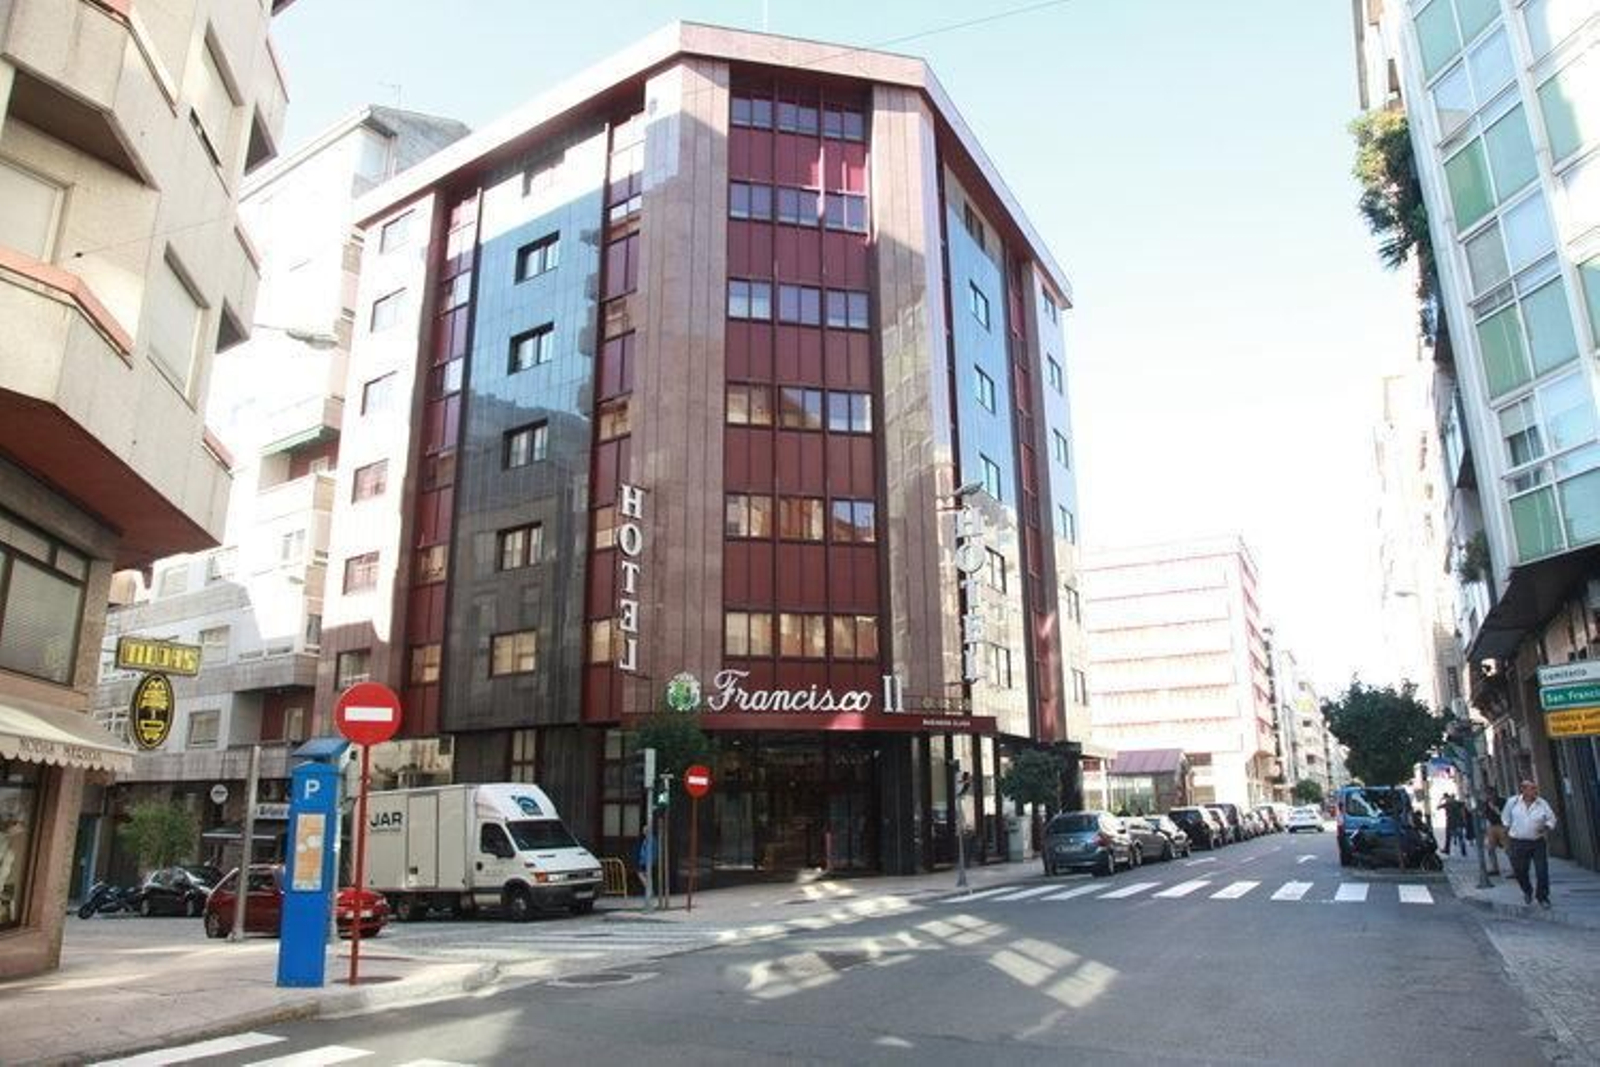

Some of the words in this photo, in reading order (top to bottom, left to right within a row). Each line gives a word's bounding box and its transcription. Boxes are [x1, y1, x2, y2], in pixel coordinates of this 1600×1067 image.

[956, 506, 985, 682] HOTEL
[707, 668, 872, 712] Francisco
[882, 675, 905, 713] II
[304, 779, 321, 800] P
[370, 811, 404, 828] JAR
